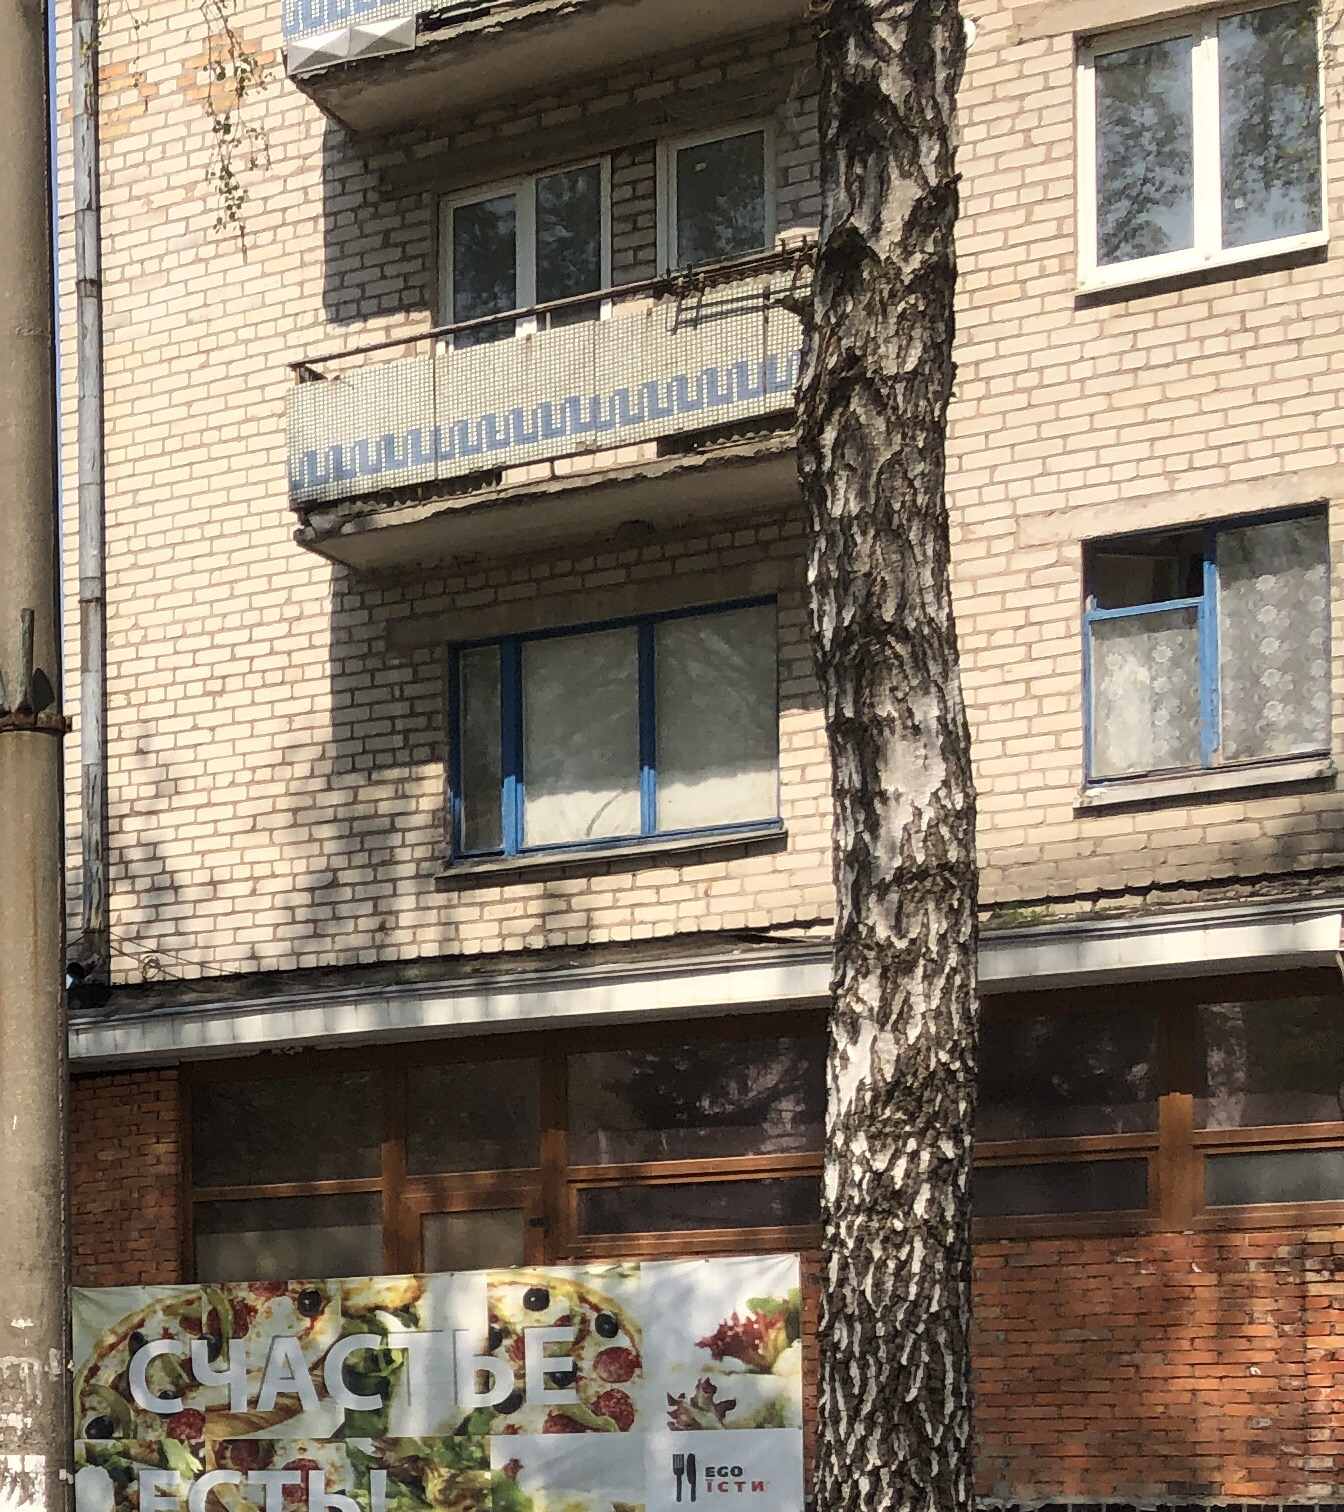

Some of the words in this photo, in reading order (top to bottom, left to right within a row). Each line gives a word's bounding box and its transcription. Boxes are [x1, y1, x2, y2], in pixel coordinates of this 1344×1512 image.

[128, 1326, 578, 1414] СЧАСТЬЕ
[704, 1465, 743, 1478] EGO
[705, 1478, 764, 1493] ЇСТИ
